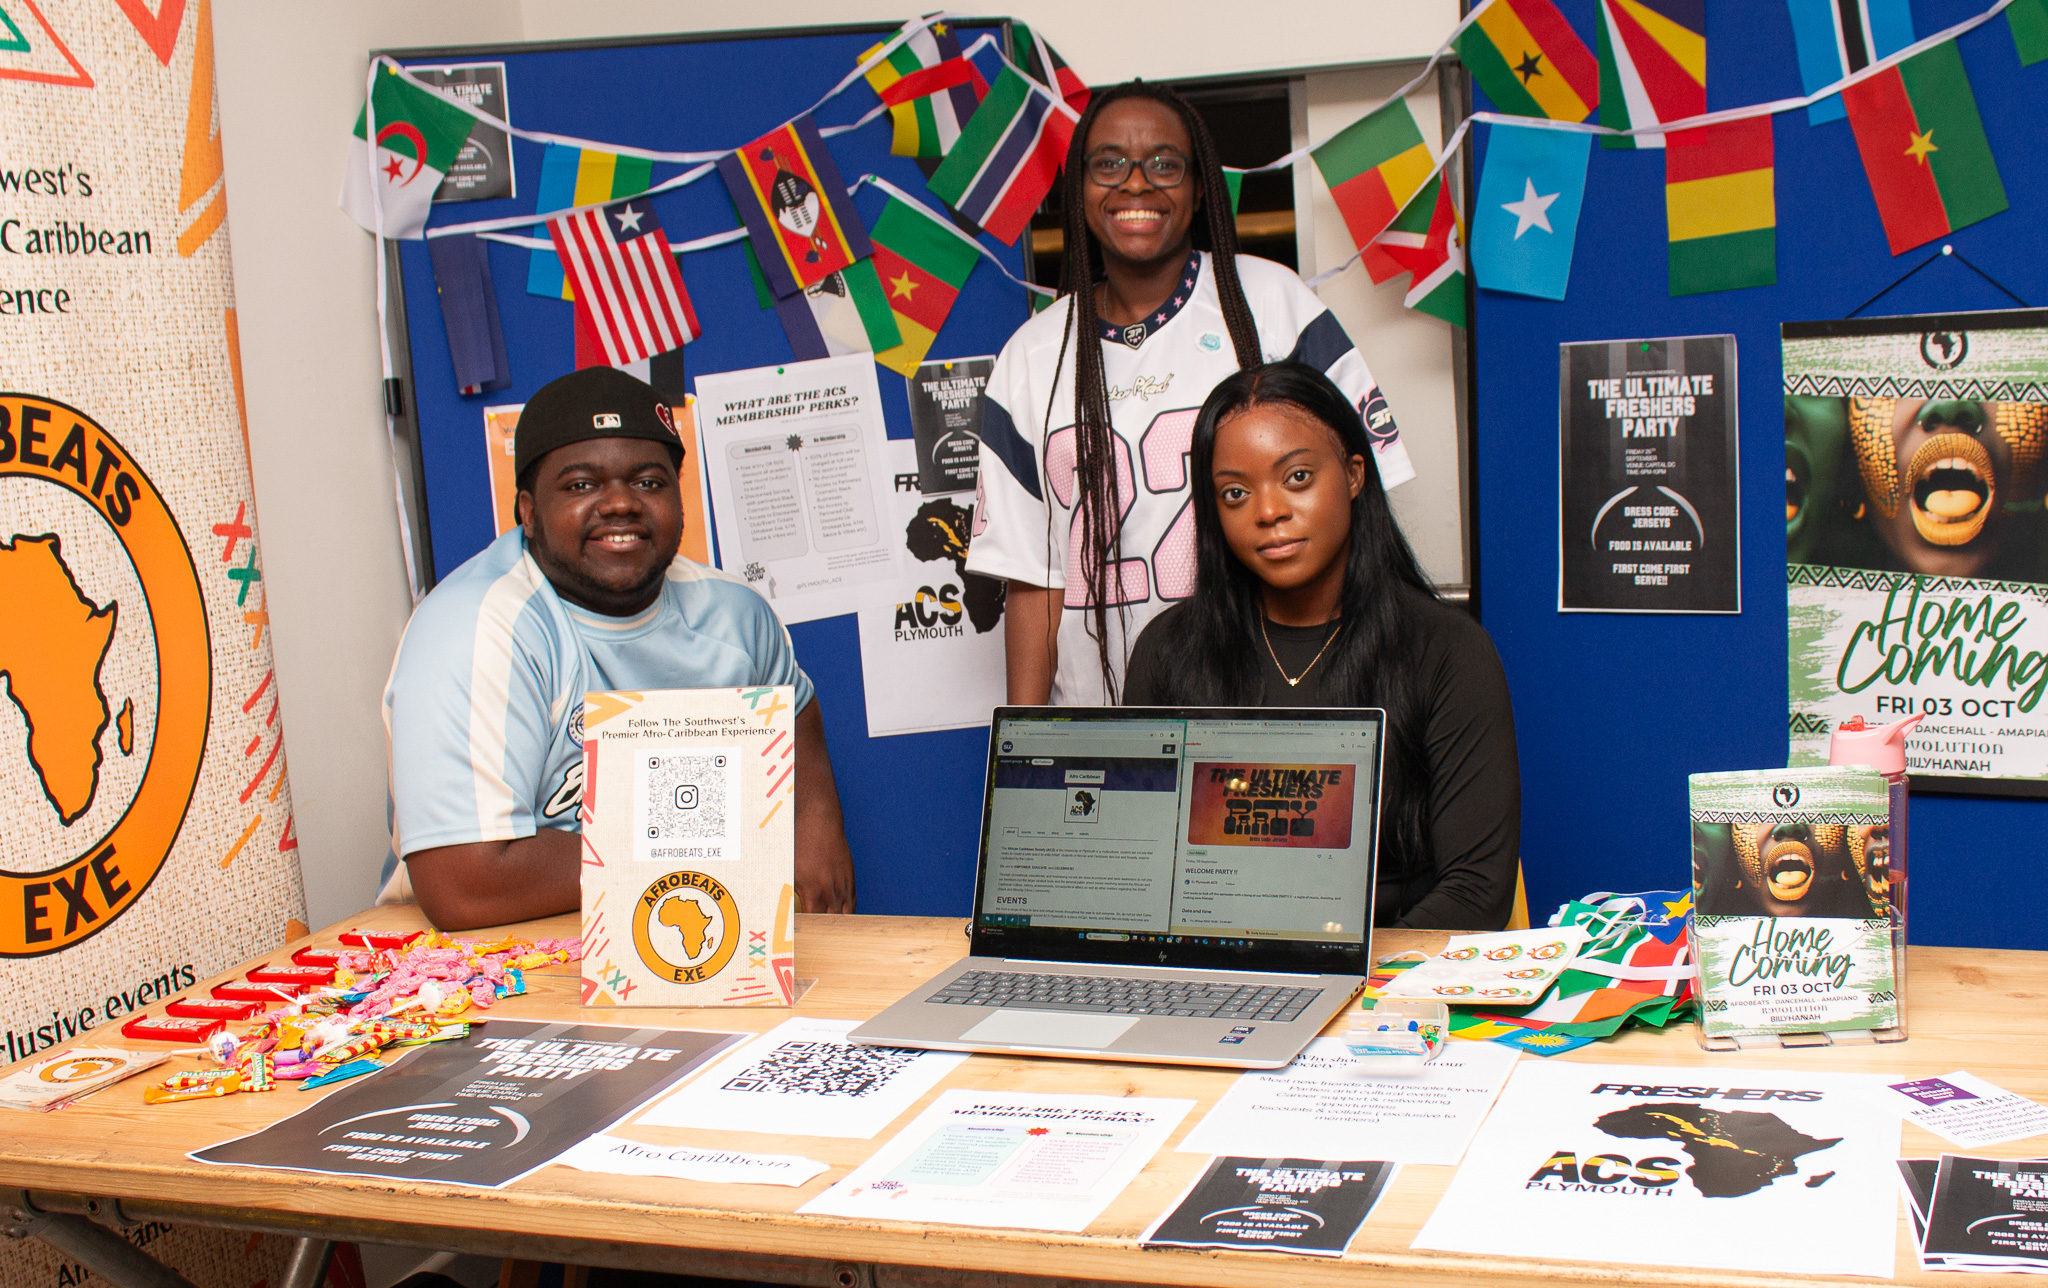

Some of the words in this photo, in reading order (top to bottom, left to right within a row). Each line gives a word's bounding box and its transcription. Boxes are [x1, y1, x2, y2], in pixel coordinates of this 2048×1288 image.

[1, 219, 152, 255] Caribbean
[922, 382, 940, 393] THE
[940, 376, 986, 391] ULTIMATE
[1588, 379, 1621, 399] THE
[1625, 375, 1713, 398] ULTIMATE
[724, 398, 765, 412] WHAT
[767, 394, 791, 406] ARE
[794, 389, 820, 403] THE
[823, 385, 847, 398] ACS
[932, 387, 978, 402] FRESHERS
[715, 404, 805, 427] MEMBERSHIP
[809, 396, 859, 413] PERKS?
[941, 398, 971, 411] PARTY
[1606, 397, 1696, 418] FRESHERS
[1622, 417, 1680, 438] PARTY
[1624, 506, 1652, 517] DRESS
[1653, 506, 1679, 517] CODE:
[1632, 517, 1671, 528] JERSEYS
[1609, 540, 1631, 551] FOOD
[1632, 540, 1642, 551] IS
[1643, 540, 1692, 551] AVAILABLE
[1612, 563, 1638, 574] FIRST
[1639, 563, 1663, 574] COME
[1664, 563, 1691, 574] FIRST
[1634, 575, 1668, 586] SERVE!!
[894, 583, 963, 630] ACS
[1868, 575, 2028, 656] Home
[895, 625, 964, 642] PLYMOUTH
[1836, 621, 2048, 713] Coming
[1877, 695, 1914, 715] FRI
[1923, 697, 1953, 716] 03
[1961, 699, 2016, 719] OCT
[628, 717, 660, 728] Follow
[663, 717, 681, 727] The
[684, 716, 746, 727] Southwest's
[602, 730, 640, 740] Premier
[642, 728, 719, 739] Afro-Caribbean
[721, 726, 776, 738] Experience
[1915, 724, 1987, 737] DANCEHALL
[1209, 768, 1246, 783] THE
[1249, 768, 1342, 785] ULTIMATE
[1222, 782, 1324, 799] FRESHERS
[650, 847, 722, 859] @AFROBEATS_EXE
[23, 842, 132, 944] EXE
[643, 873, 726, 908] AFROBEATS
[996, 896, 1028, 905] EVENTS
[1753, 917, 1834, 964] Home
[673, 966, 706, 983] EXE
[1728, 944, 1856, 989] Coming
[105, 964, 197, 1020] events
[1753, 985, 1776, 996] FRI
[1780, 984, 1798, 995] 03
[1802, 982, 1832, 994] OCT
[1730, 999, 1770, 1007] AFROBEATS
[1775, 997, 1816, 1005] DANCEHALL
[473, 1037, 536, 1051] THE
[531, 1041, 683, 1061] ULTIMATE
[479, 1051, 635, 1071] FRESHERS
[1297, 1053, 1324, 1062] Why
[485, 1063, 592, 1080] PARTY
[467, 1083, 520, 1091] SEPTEMBER
[1589, 1083, 1825, 1102] FRESHERS
[974, 1104, 1026, 1112] WHAT
[1251, 1104, 1313, 1113] Discounts
[1316, 1102, 1396, 1110] opportunities
[1383, 1098, 1451, 1106] networking
[406, 1113, 459, 1123] DRESS
[456, 1116, 501, 1127] CODE:
[951, 1110, 1077, 1120] MEMBERSHIP
[1082, 1115, 1155, 1123] PERKS?
[407, 1121, 478, 1133] JERSEYS
[342, 1131, 386, 1141] FOOD
[382, 1134, 405, 1142] IS
[401, 1136, 492, 1149] AVAILABLE
[322, 1144, 371, 1153] FIRST
[365, 1146, 417, 1158] COME
[411, 1151, 464, 1162] FIRST
[609, 1144, 662, 1160] Afro
[668, 1150, 791, 1169] Caribbean
[1236, 1168, 1271, 1178] THE
[1273, 1168, 1366, 1182] ULTIMATE
[1528, 1151, 1683, 1188] ACS
[1972, 1170, 2011, 1181] THE
[1248, 1176, 1342, 1188] FRESHERS
[1259, 1184, 1322, 1194] PARTY
[1525, 1181, 1673, 1197] PLYMOUTH
[1255, 1222, 1310, 1230] AVAILABLE
